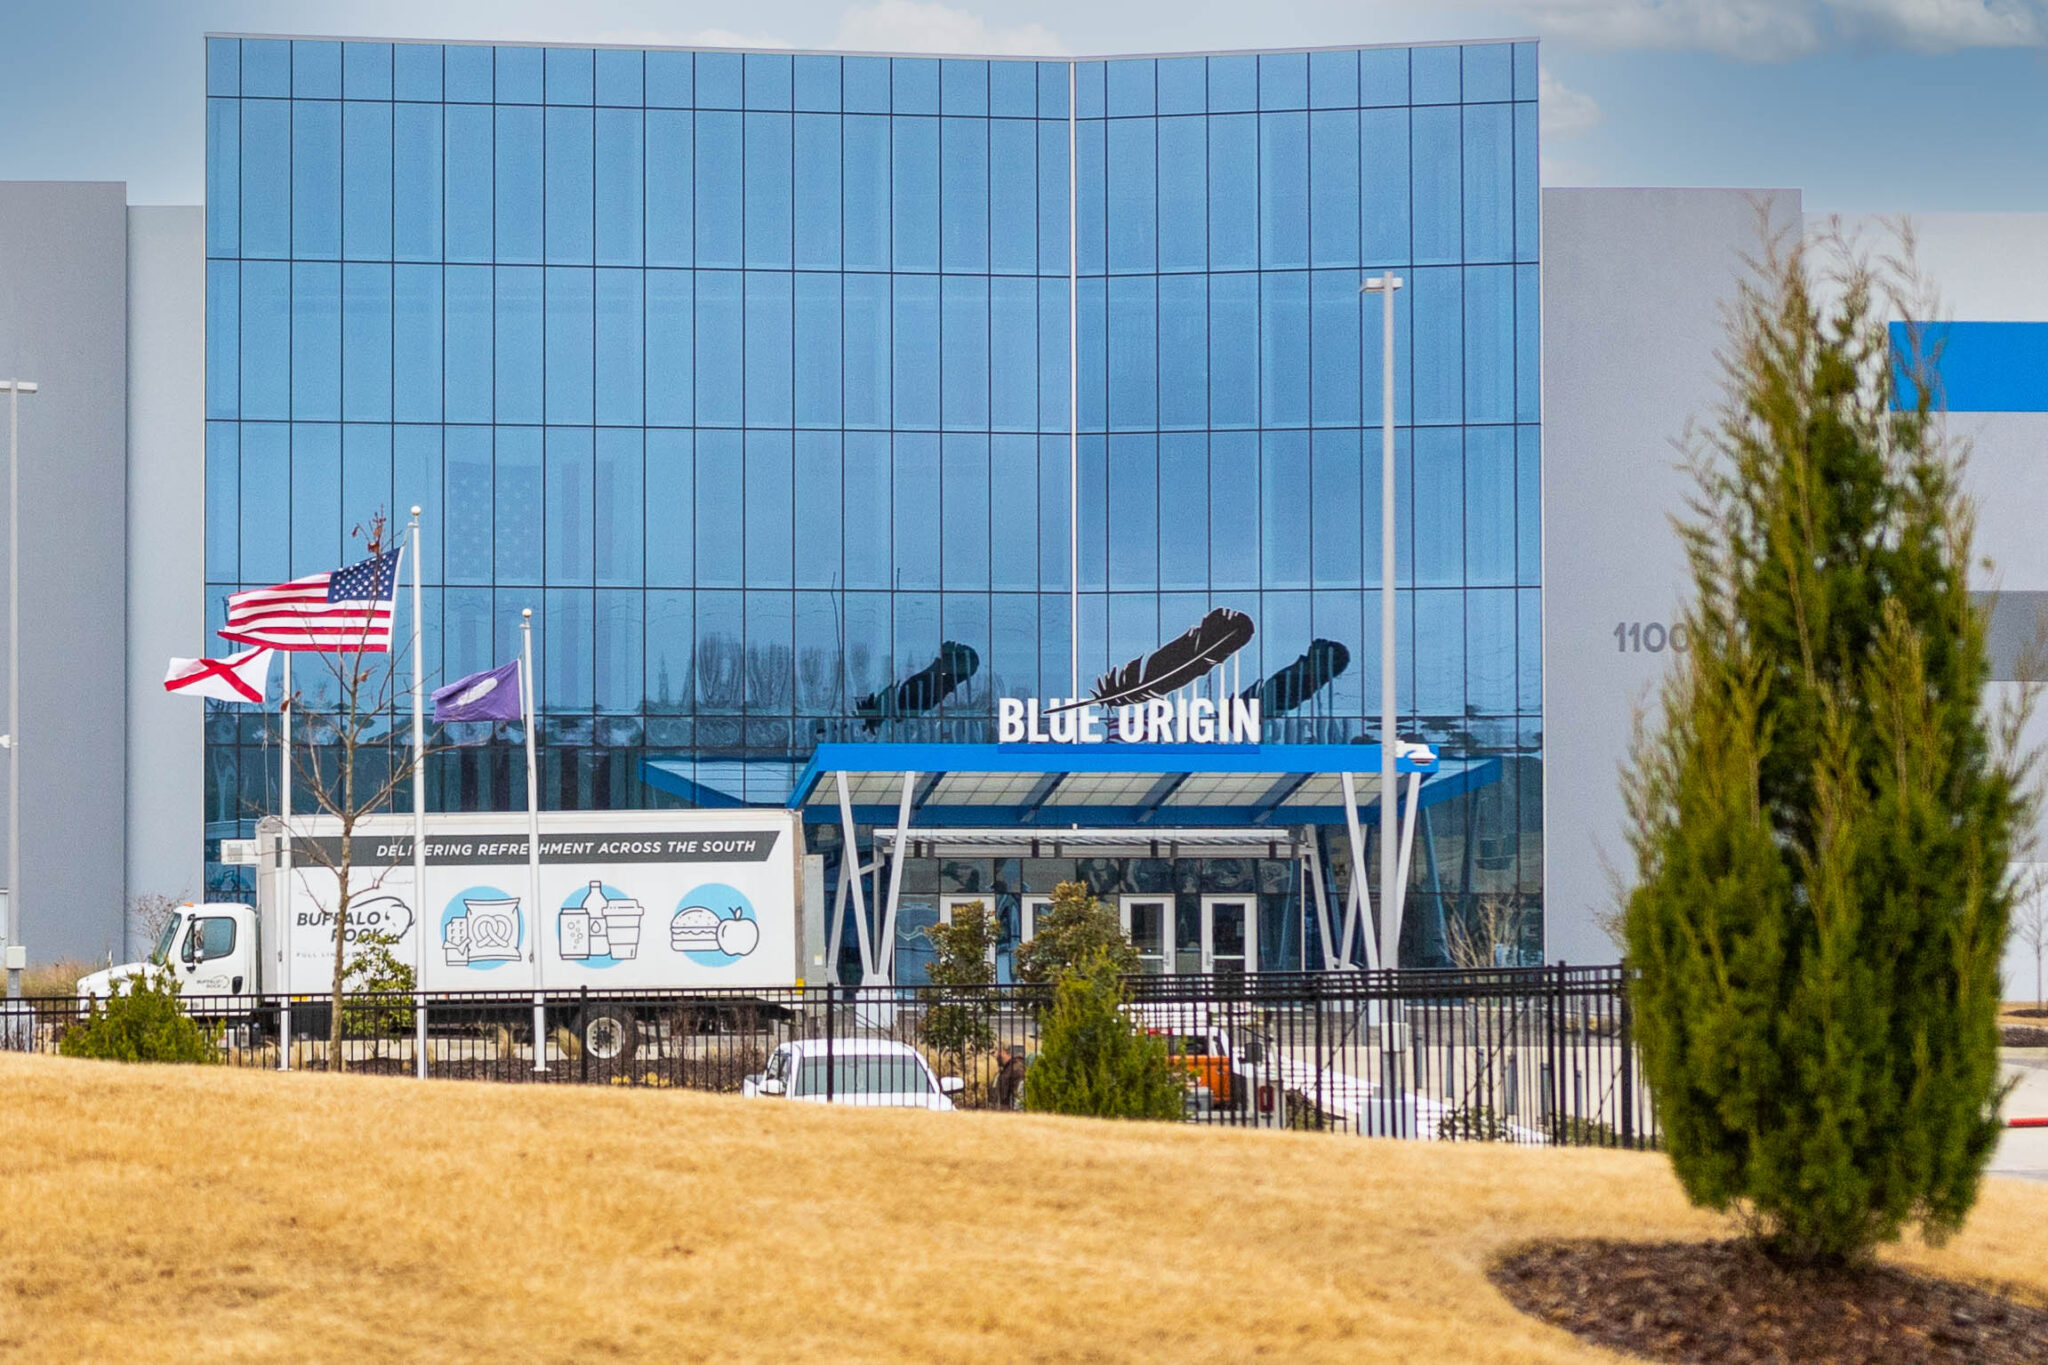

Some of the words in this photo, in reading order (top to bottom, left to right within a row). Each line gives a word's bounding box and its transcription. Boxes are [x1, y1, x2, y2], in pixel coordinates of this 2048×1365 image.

[1613, 622, 1690, 653] 1100
[999, 698, 1103, 743] BLUE
[1118, 698, 1261, 743] ORIGIN
[376, 843, 473, 857] DELIERING
[477, 842, 595, 856] REFREHMENT
[598, 841, 662, 854] ACROSS
[667, 841, 699, 853] THE
[702, 840, 757, 853] SOUTH
